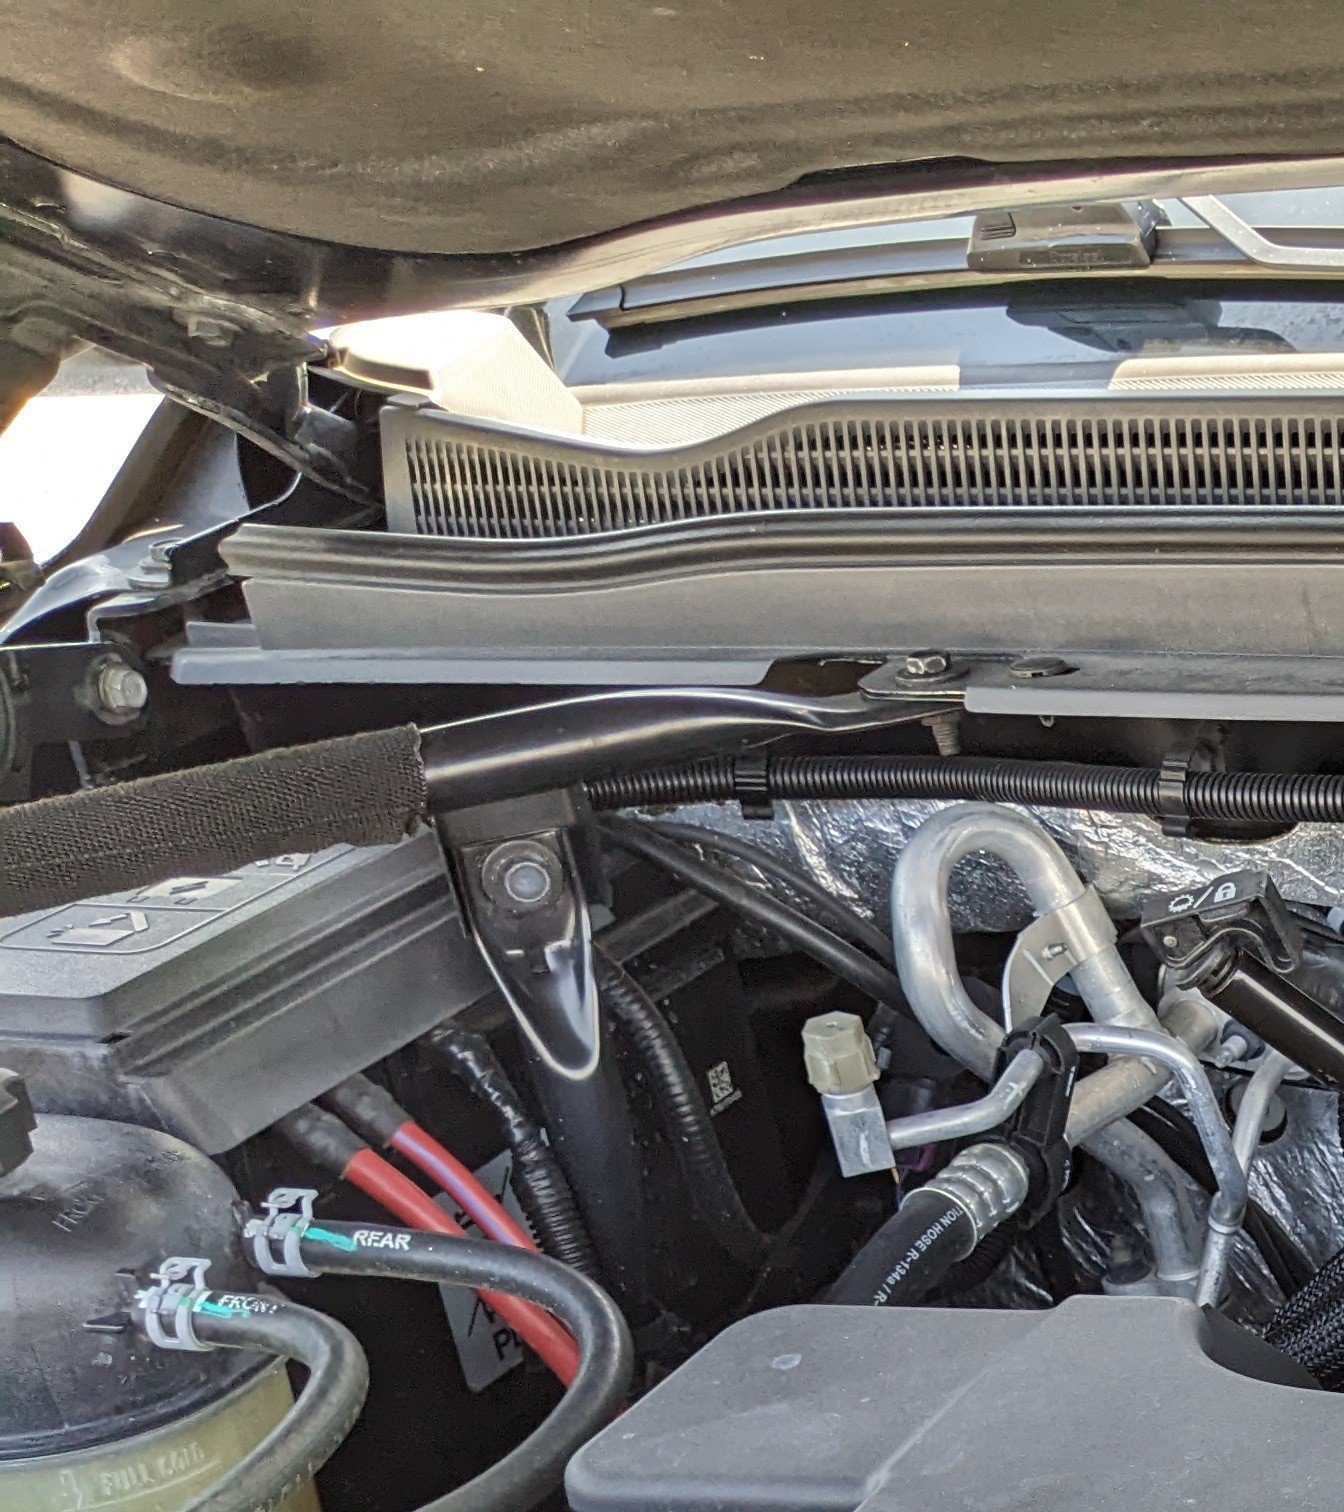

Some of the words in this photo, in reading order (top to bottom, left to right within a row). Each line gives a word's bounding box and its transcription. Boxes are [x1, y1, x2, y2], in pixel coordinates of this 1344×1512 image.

[352, 1229, 412, 1251] REAR
[914, 1222, 945, 1253] HOSE
[886, 1247, 920, 1285] R-134a
